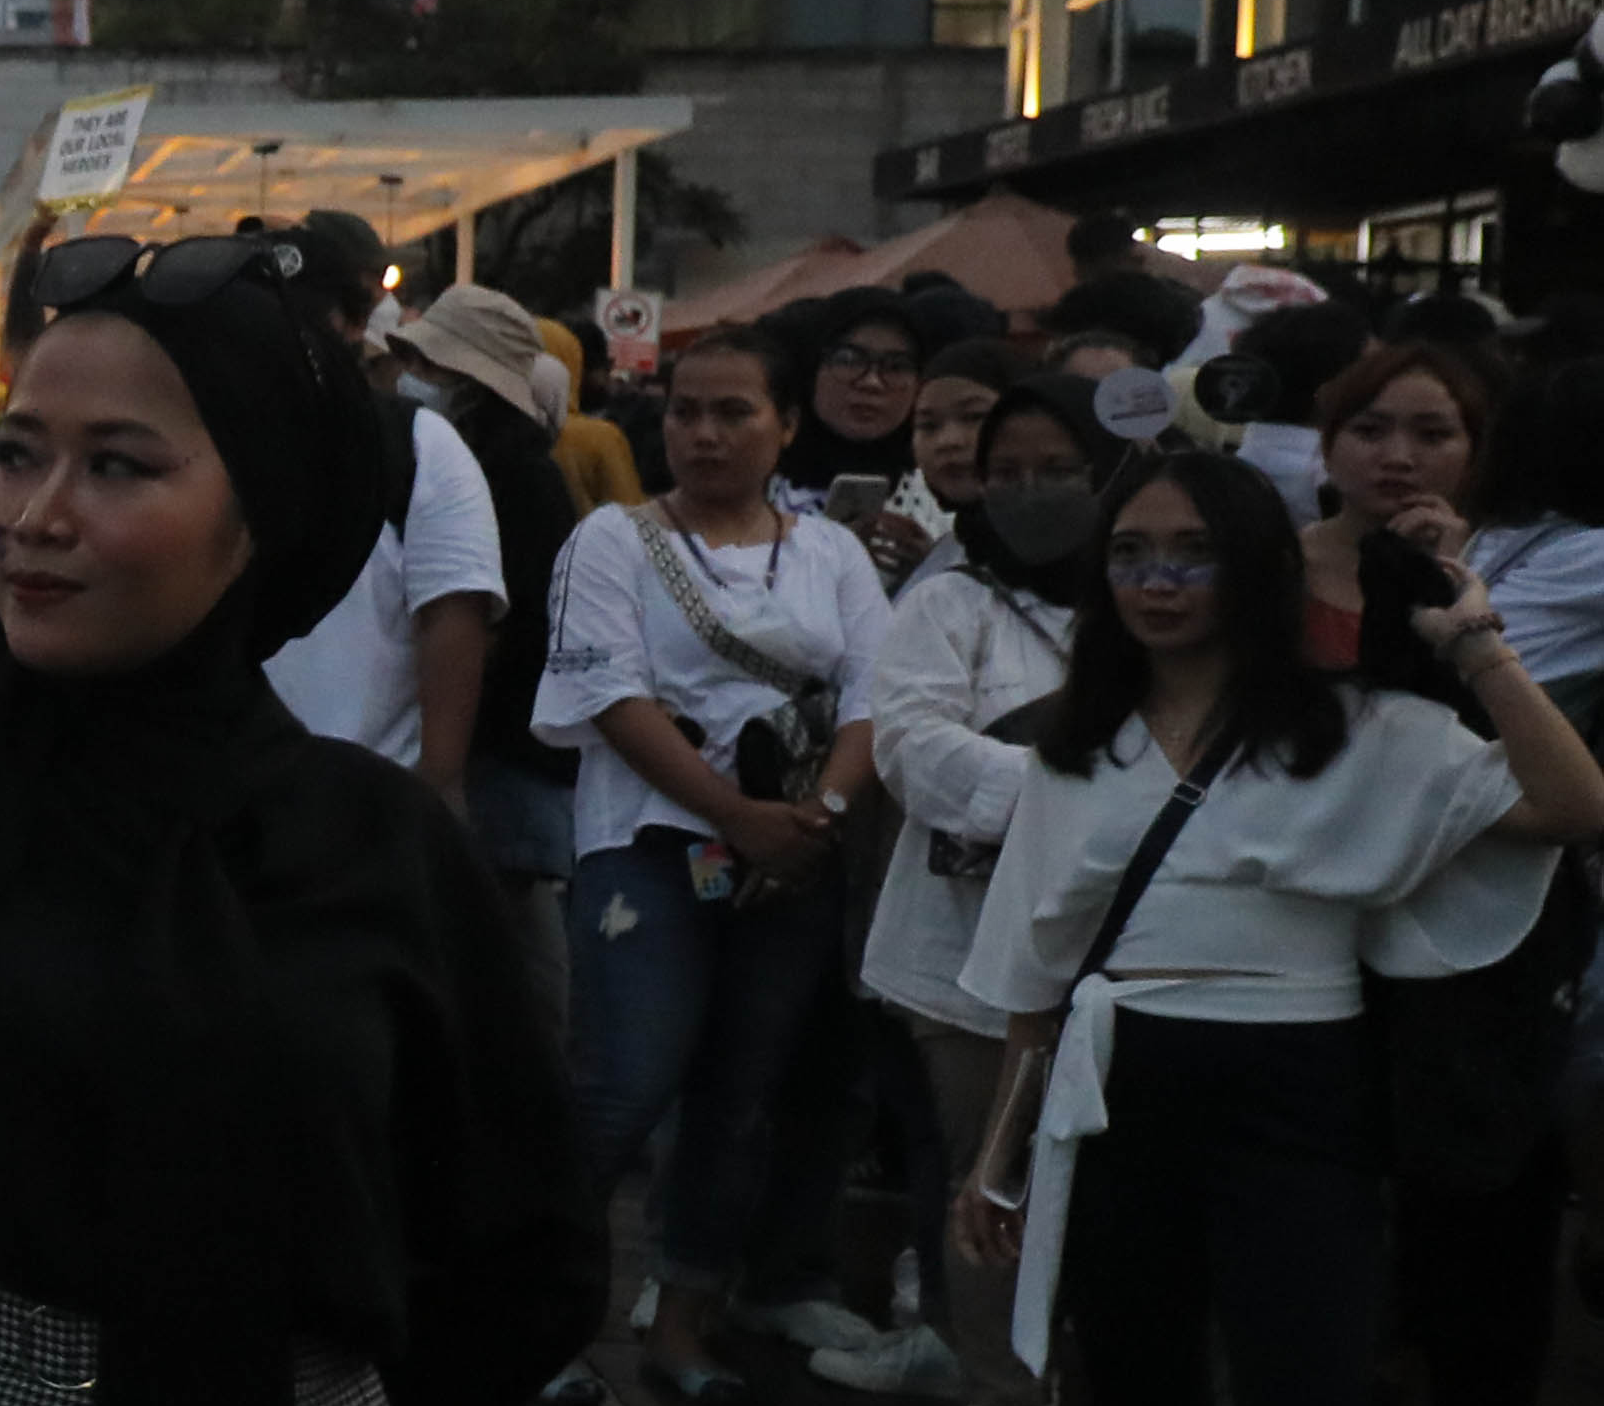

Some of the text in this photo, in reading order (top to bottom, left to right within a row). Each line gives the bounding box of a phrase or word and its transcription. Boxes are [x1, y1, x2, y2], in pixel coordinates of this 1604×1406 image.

[1394, 16, 1433, 70] ALL
[1437, 0, 1487, 57] DAY
[105, 108, 129, 128] ARE
[59, 137, 86, 156] OUR
